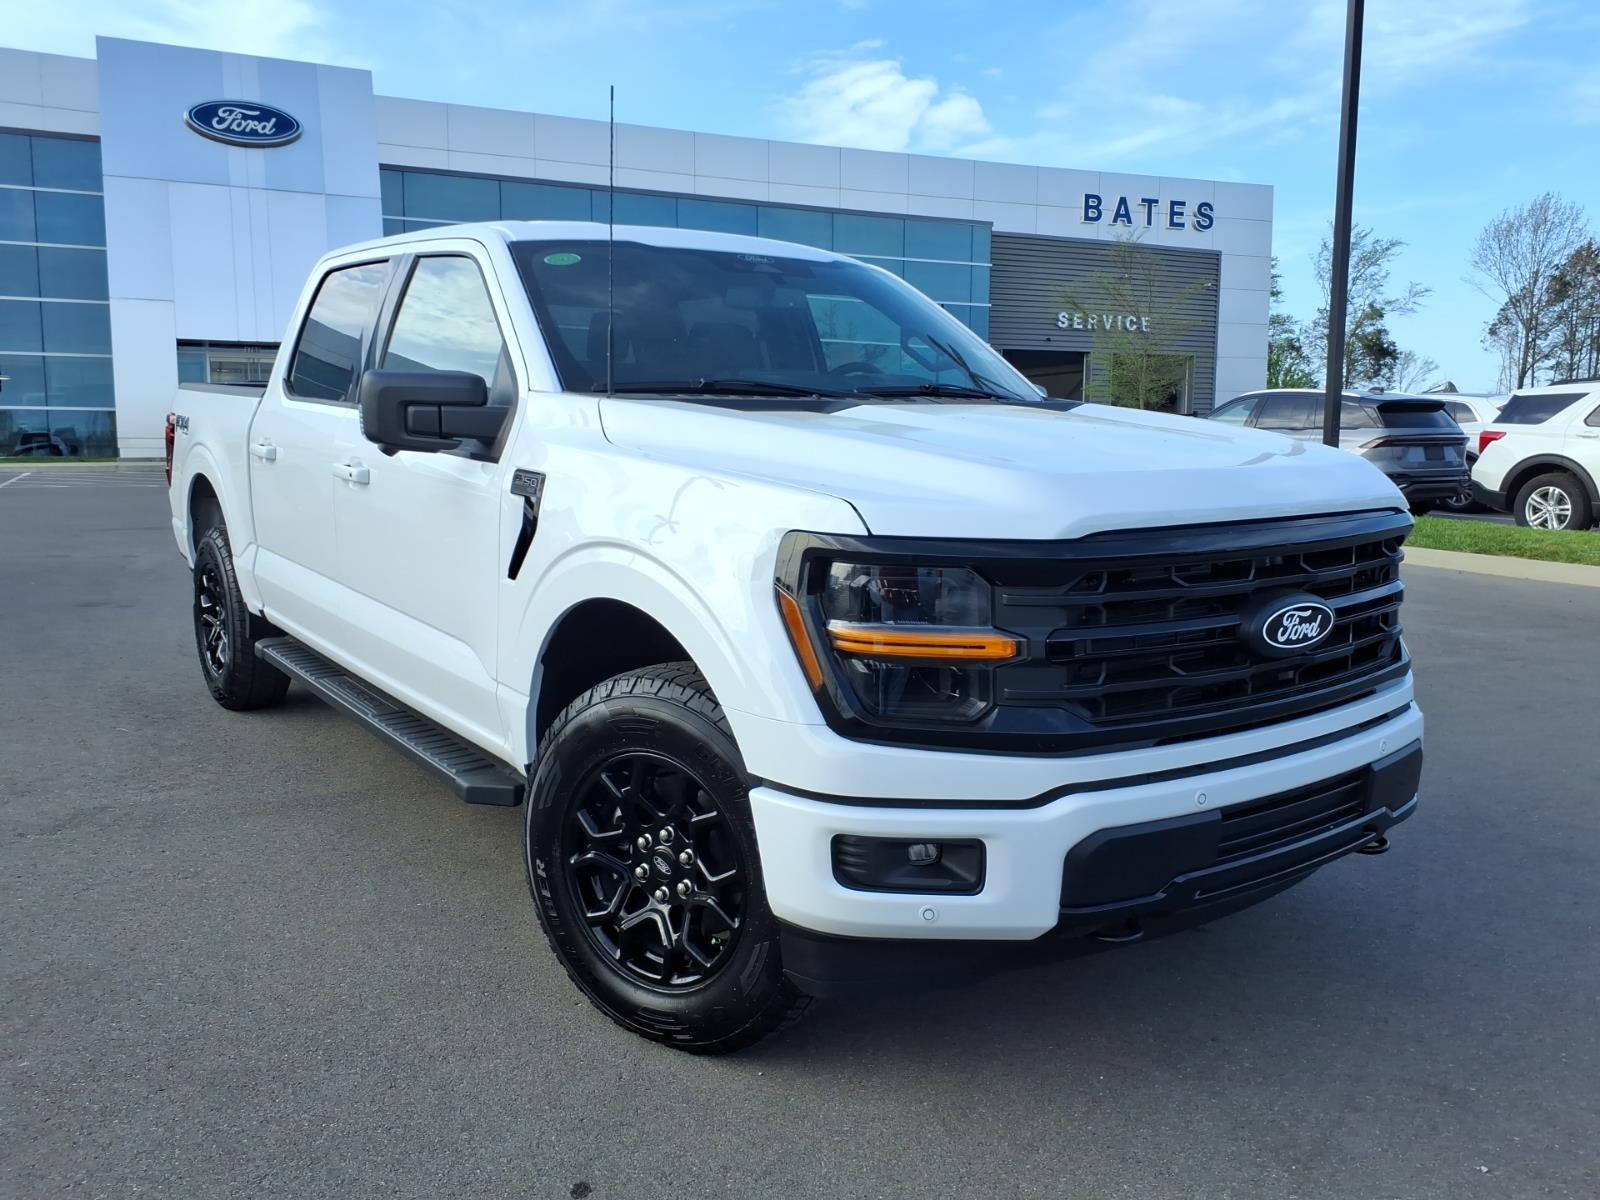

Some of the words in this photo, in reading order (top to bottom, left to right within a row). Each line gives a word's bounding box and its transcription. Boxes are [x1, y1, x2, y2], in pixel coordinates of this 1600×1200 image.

[211, 106, 277, 135] Ford
[1082, 192, 1215, 231] BATES
[1057, 311, 1151, 332] SERVICE
[1277, 609, 1322, 643] Ford
